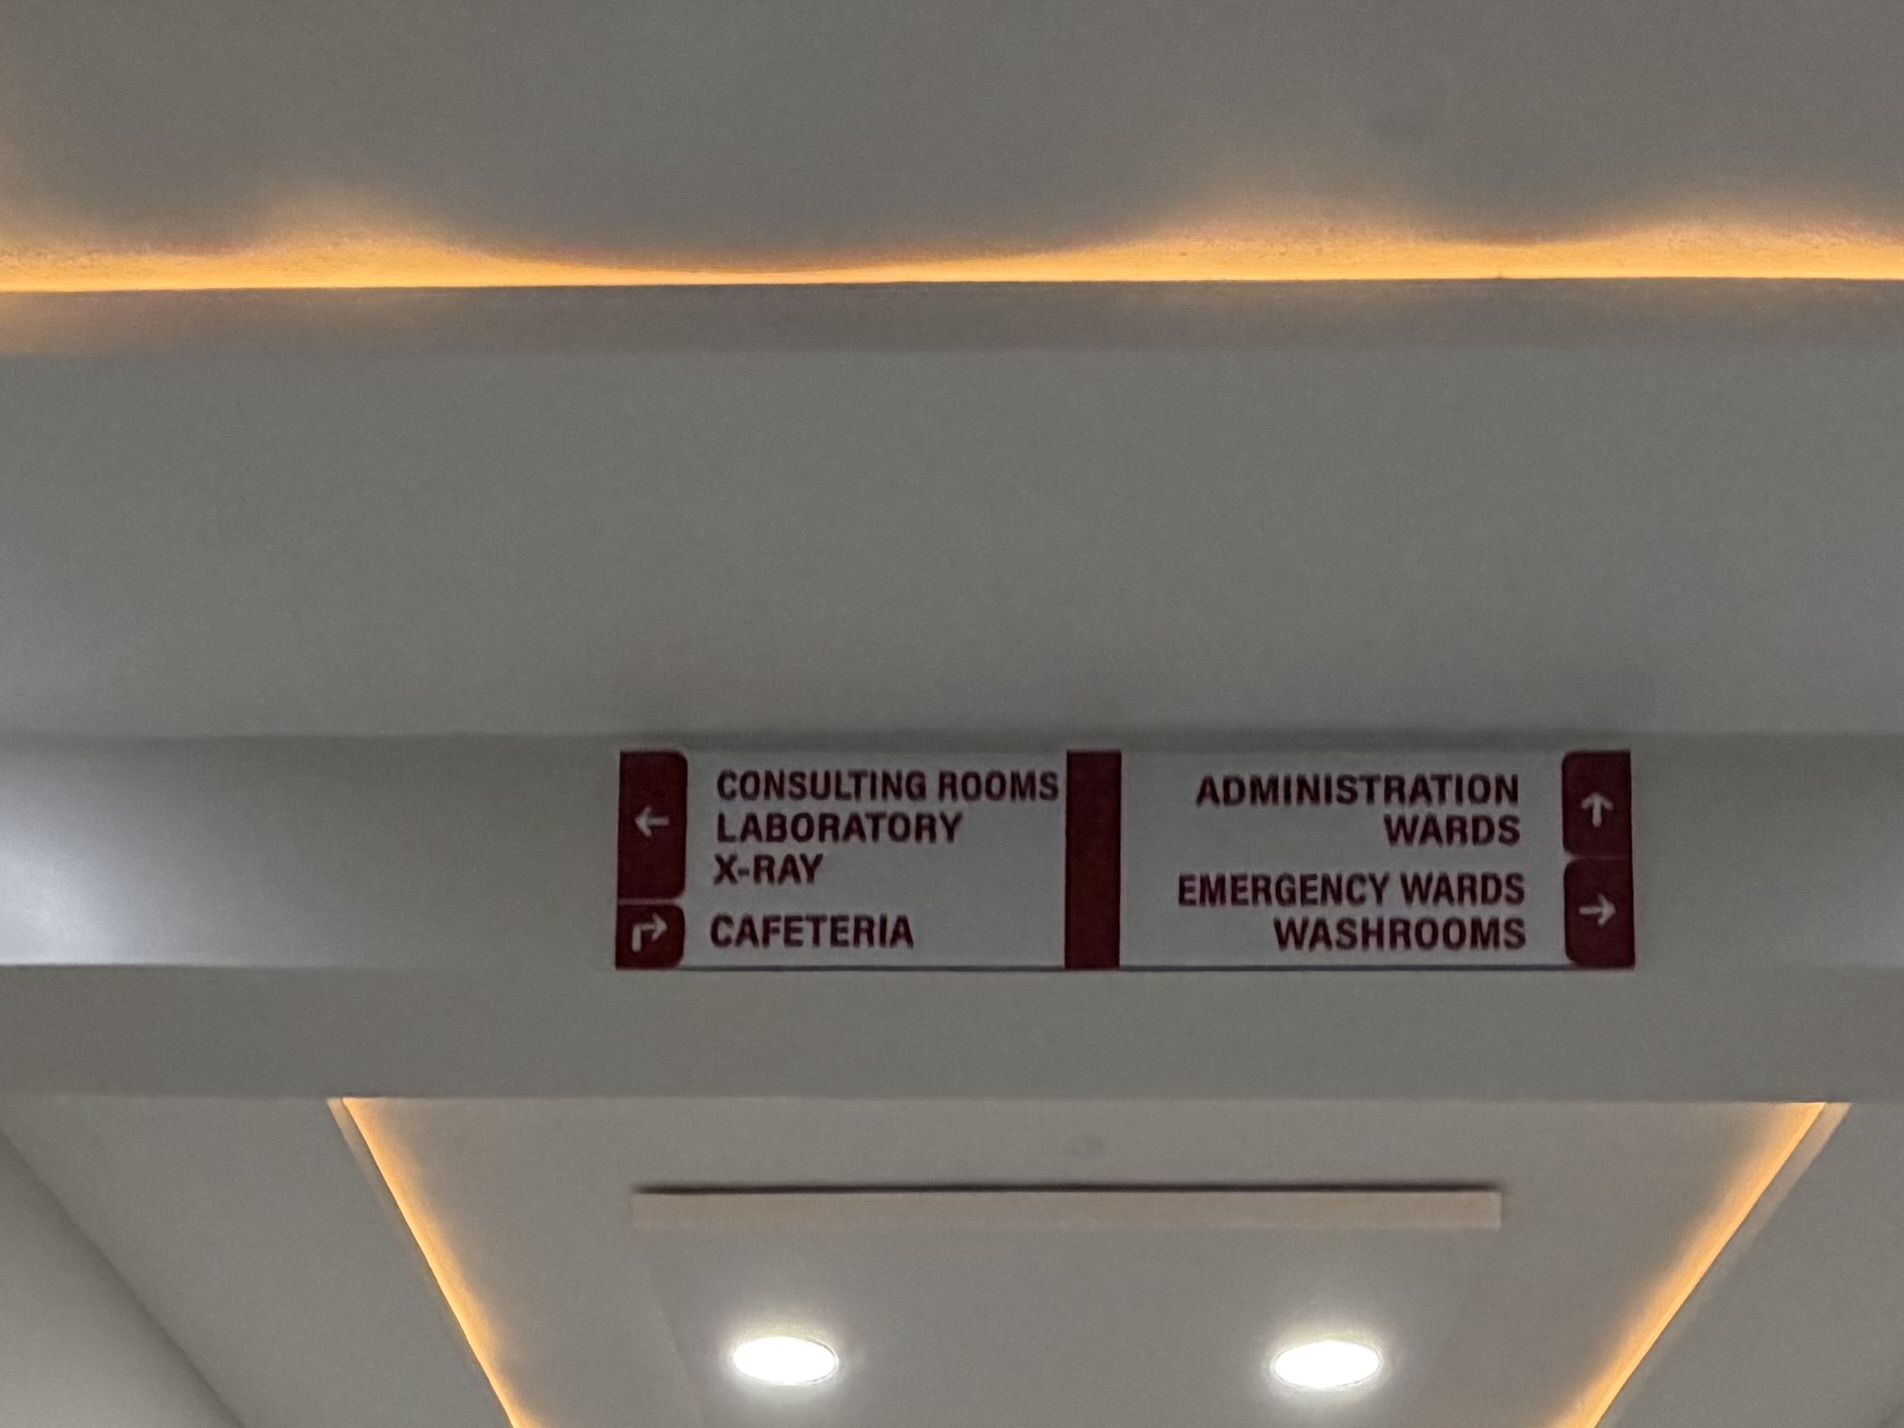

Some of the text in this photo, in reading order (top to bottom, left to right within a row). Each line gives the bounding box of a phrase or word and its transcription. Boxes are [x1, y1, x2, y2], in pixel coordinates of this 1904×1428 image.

[716, 769, 1059, 801] CONSULTING ROOMS
[1196, 773, 1520, 807] ADMINISTRATION
[716, 811, 963, 844] LABORATORY
[1383, 813, 1521, 847] WARDS
[713, 853, 824, 885] X-RAY
[1178, 871, 1526, 907] EMERGENCY WARDS
[710, 913, 914, 948] CAFETERIA
[1273, 916, 1527, 951] WASHROOMS
